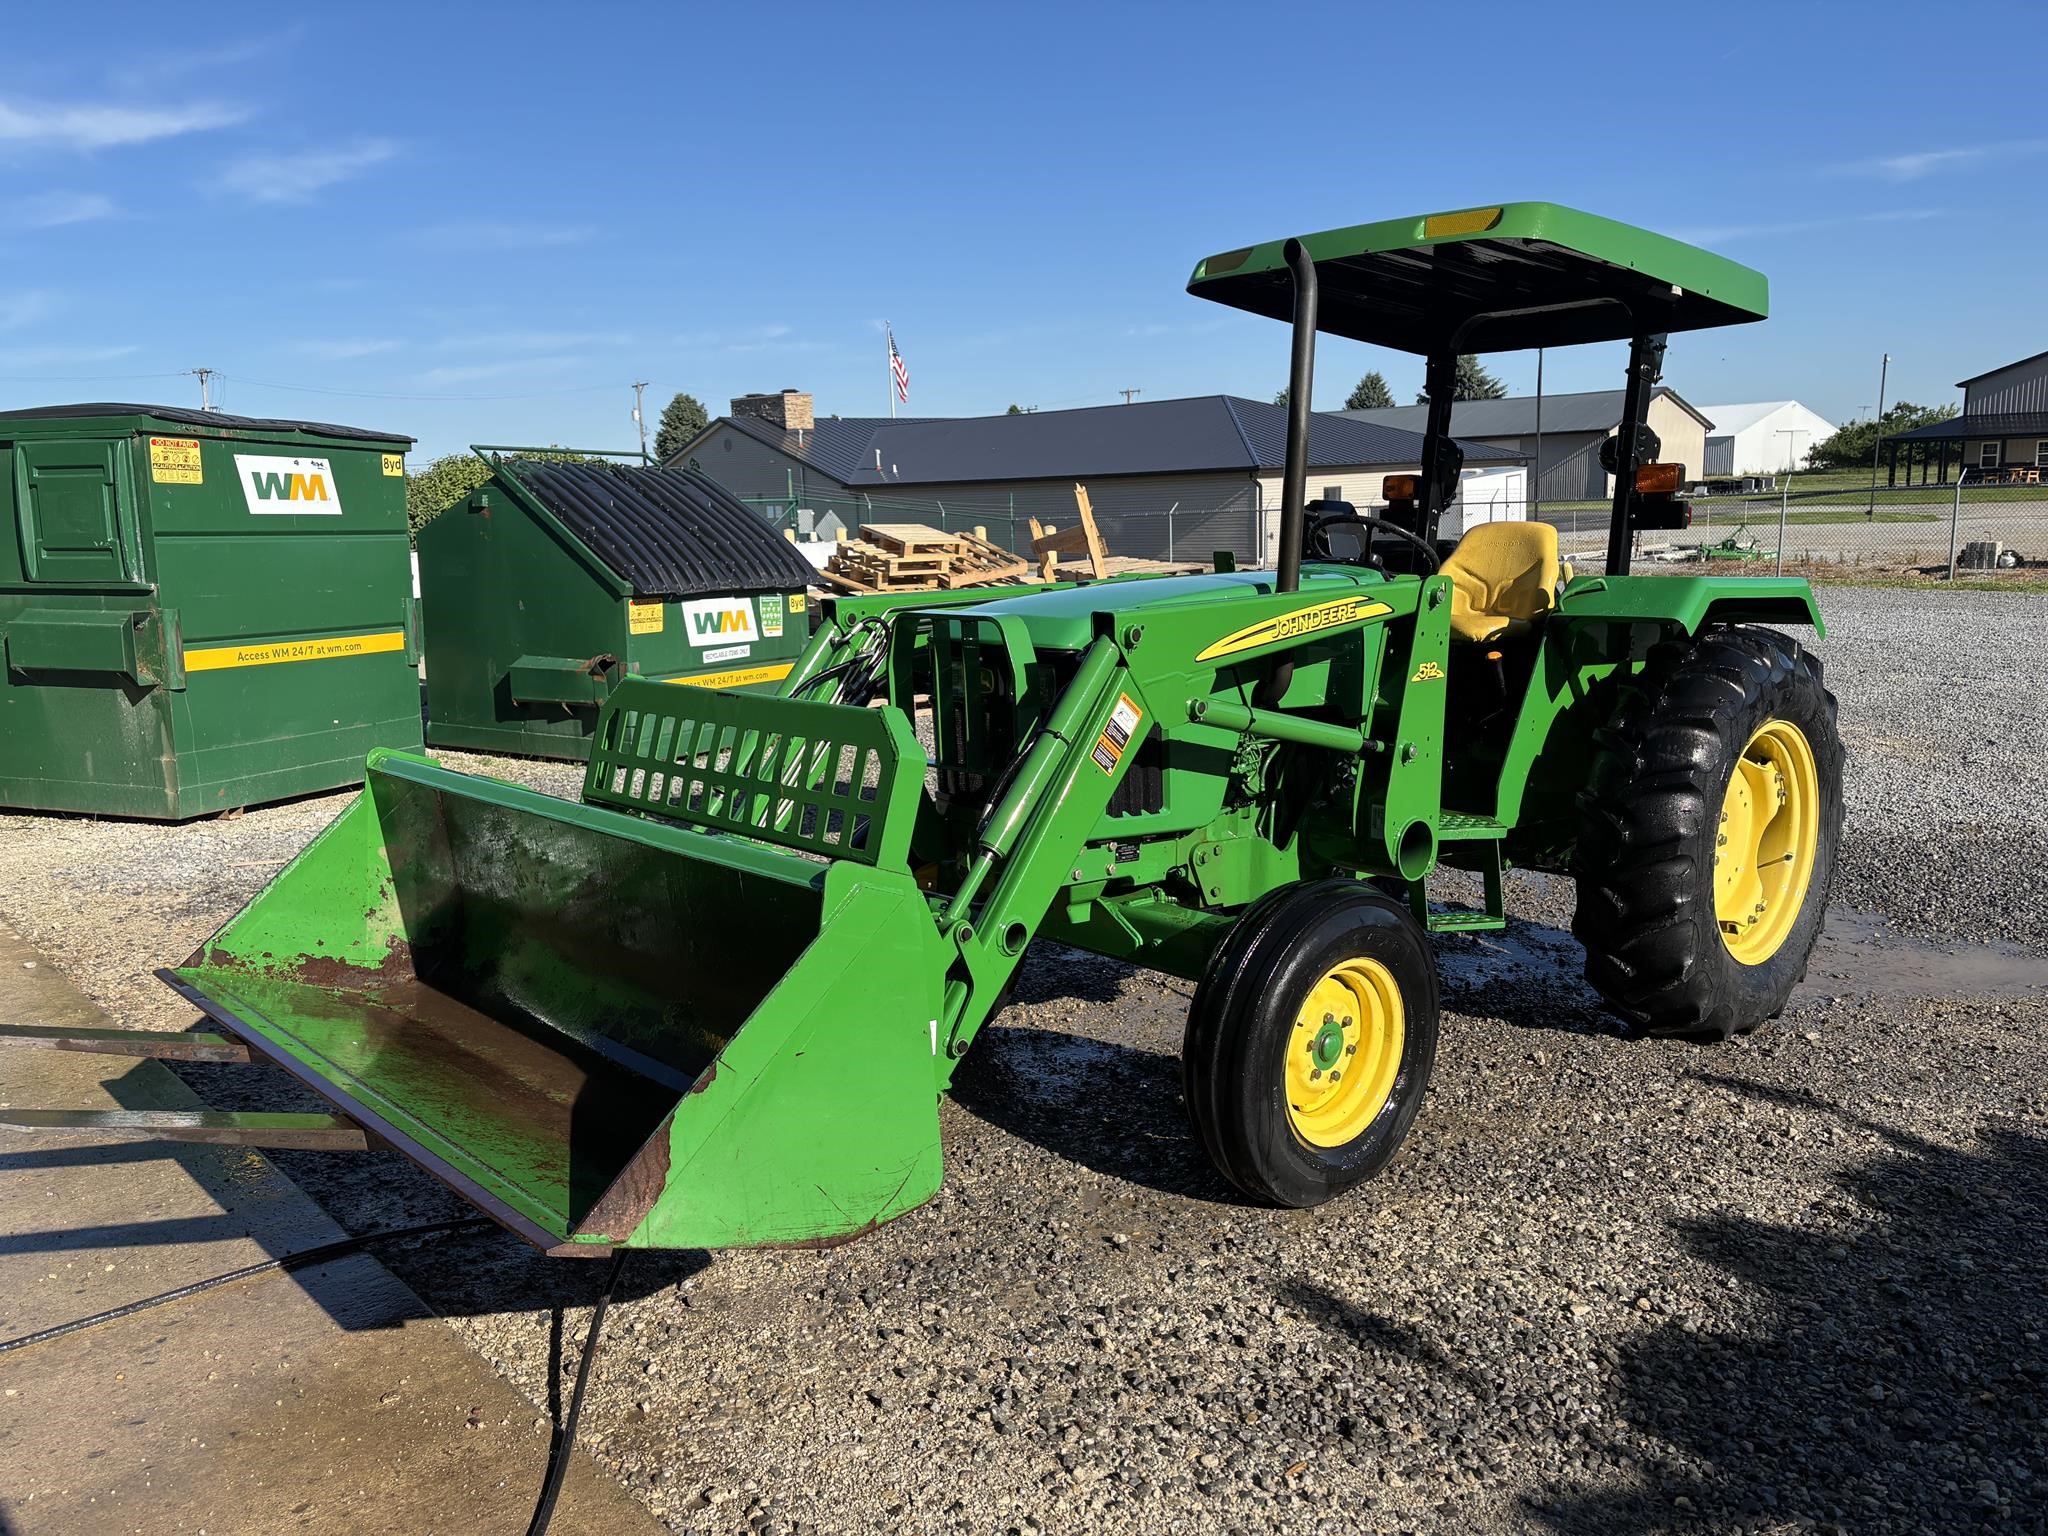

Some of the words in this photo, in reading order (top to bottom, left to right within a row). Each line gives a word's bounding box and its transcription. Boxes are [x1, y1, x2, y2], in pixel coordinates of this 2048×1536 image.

[384, 457, 401, 472] 8yd
[251, 471, 329, 501] WM
[791, 597, 804, 610] 8yd
[693, 610, 750, 635] WM
[1271, 612, 1310, 639] JOHN
[1309, 602, 1358, 629] DEERE
[237, 651, 270, 662] Access
[272, 647, 290, 658] WM
[292, 645, 314, 656] 24/7
[316, 646, 325, 654] at
[326, 643, 362, 654] wm.com
[702, 677, 716, 687] WM
[717, 675, 734, 685] 24/7
[743, 672, 769, 682] wm.com
[1419, 661, 1438, 680] 512
